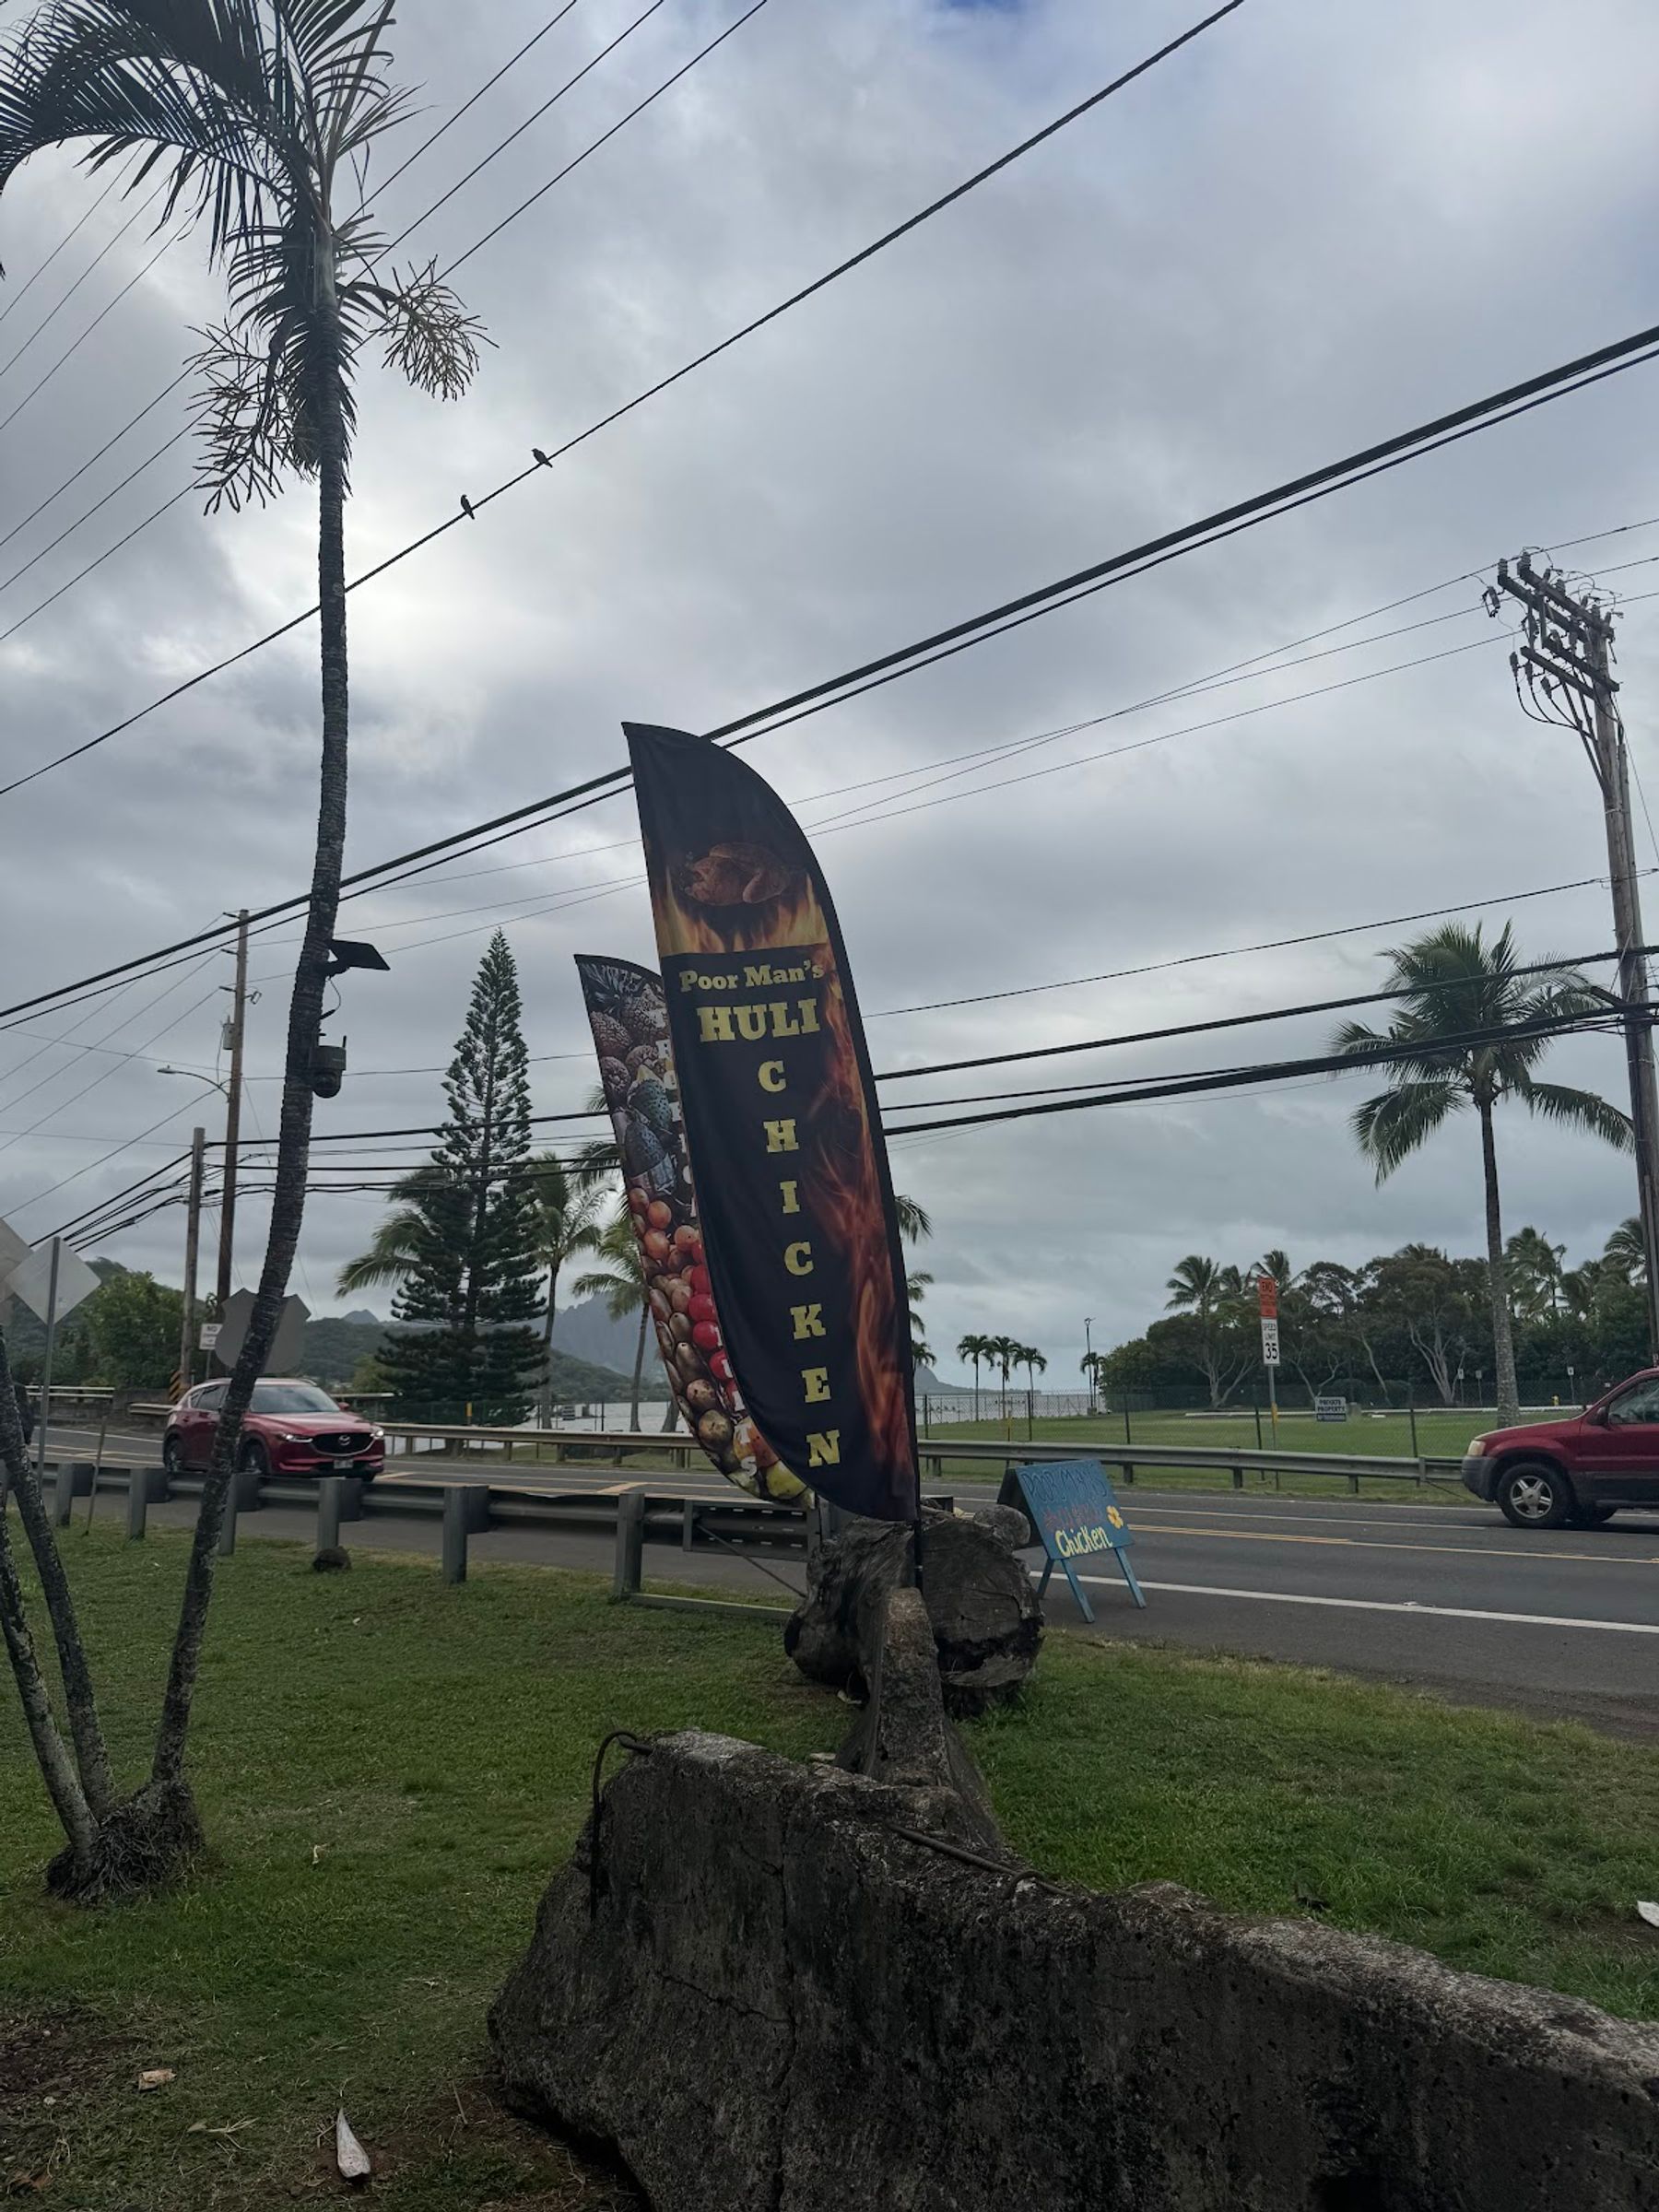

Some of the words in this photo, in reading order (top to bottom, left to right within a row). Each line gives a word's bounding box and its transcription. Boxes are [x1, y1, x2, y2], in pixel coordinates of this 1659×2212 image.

[679, 970, 739, 993] Poor
[743, 959, 825, 987] Man's
[697, 998, 820, 1042] HULI
[758, 1060, 841, 1467] CHICKEN
[1265, 1342, 1278, 1359] 35
